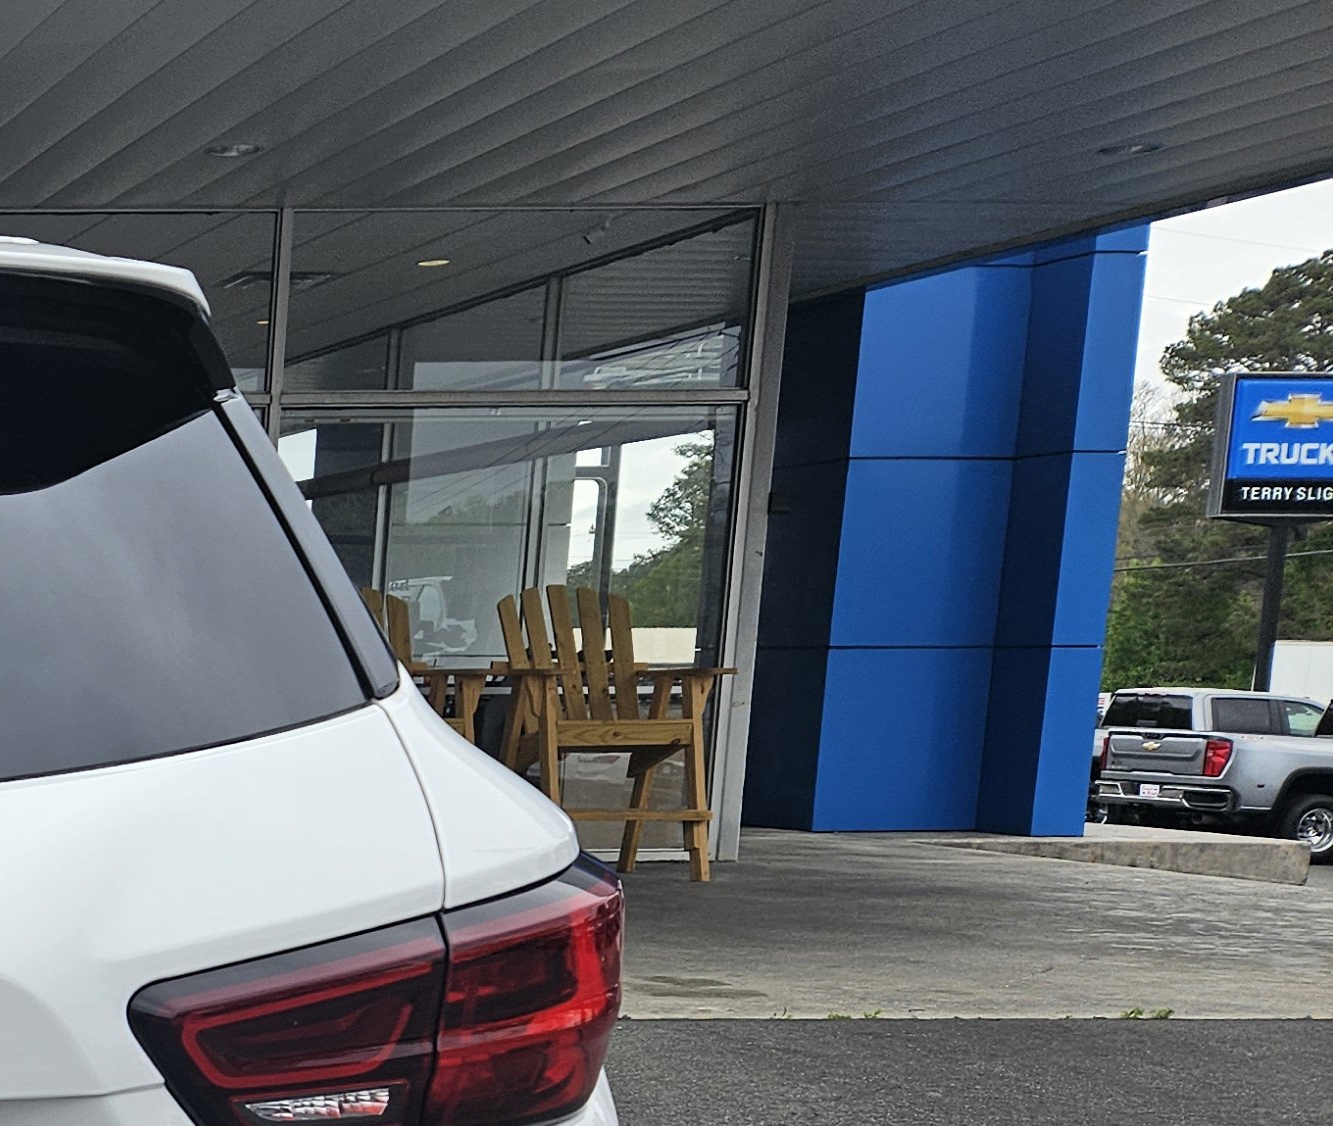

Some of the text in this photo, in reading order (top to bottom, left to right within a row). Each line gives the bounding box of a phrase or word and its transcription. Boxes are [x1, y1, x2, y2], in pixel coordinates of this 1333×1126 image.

[1242, 442, 1333, 465] TRUCK
[1241, 486, 1333, 500] TERRY SLIG
